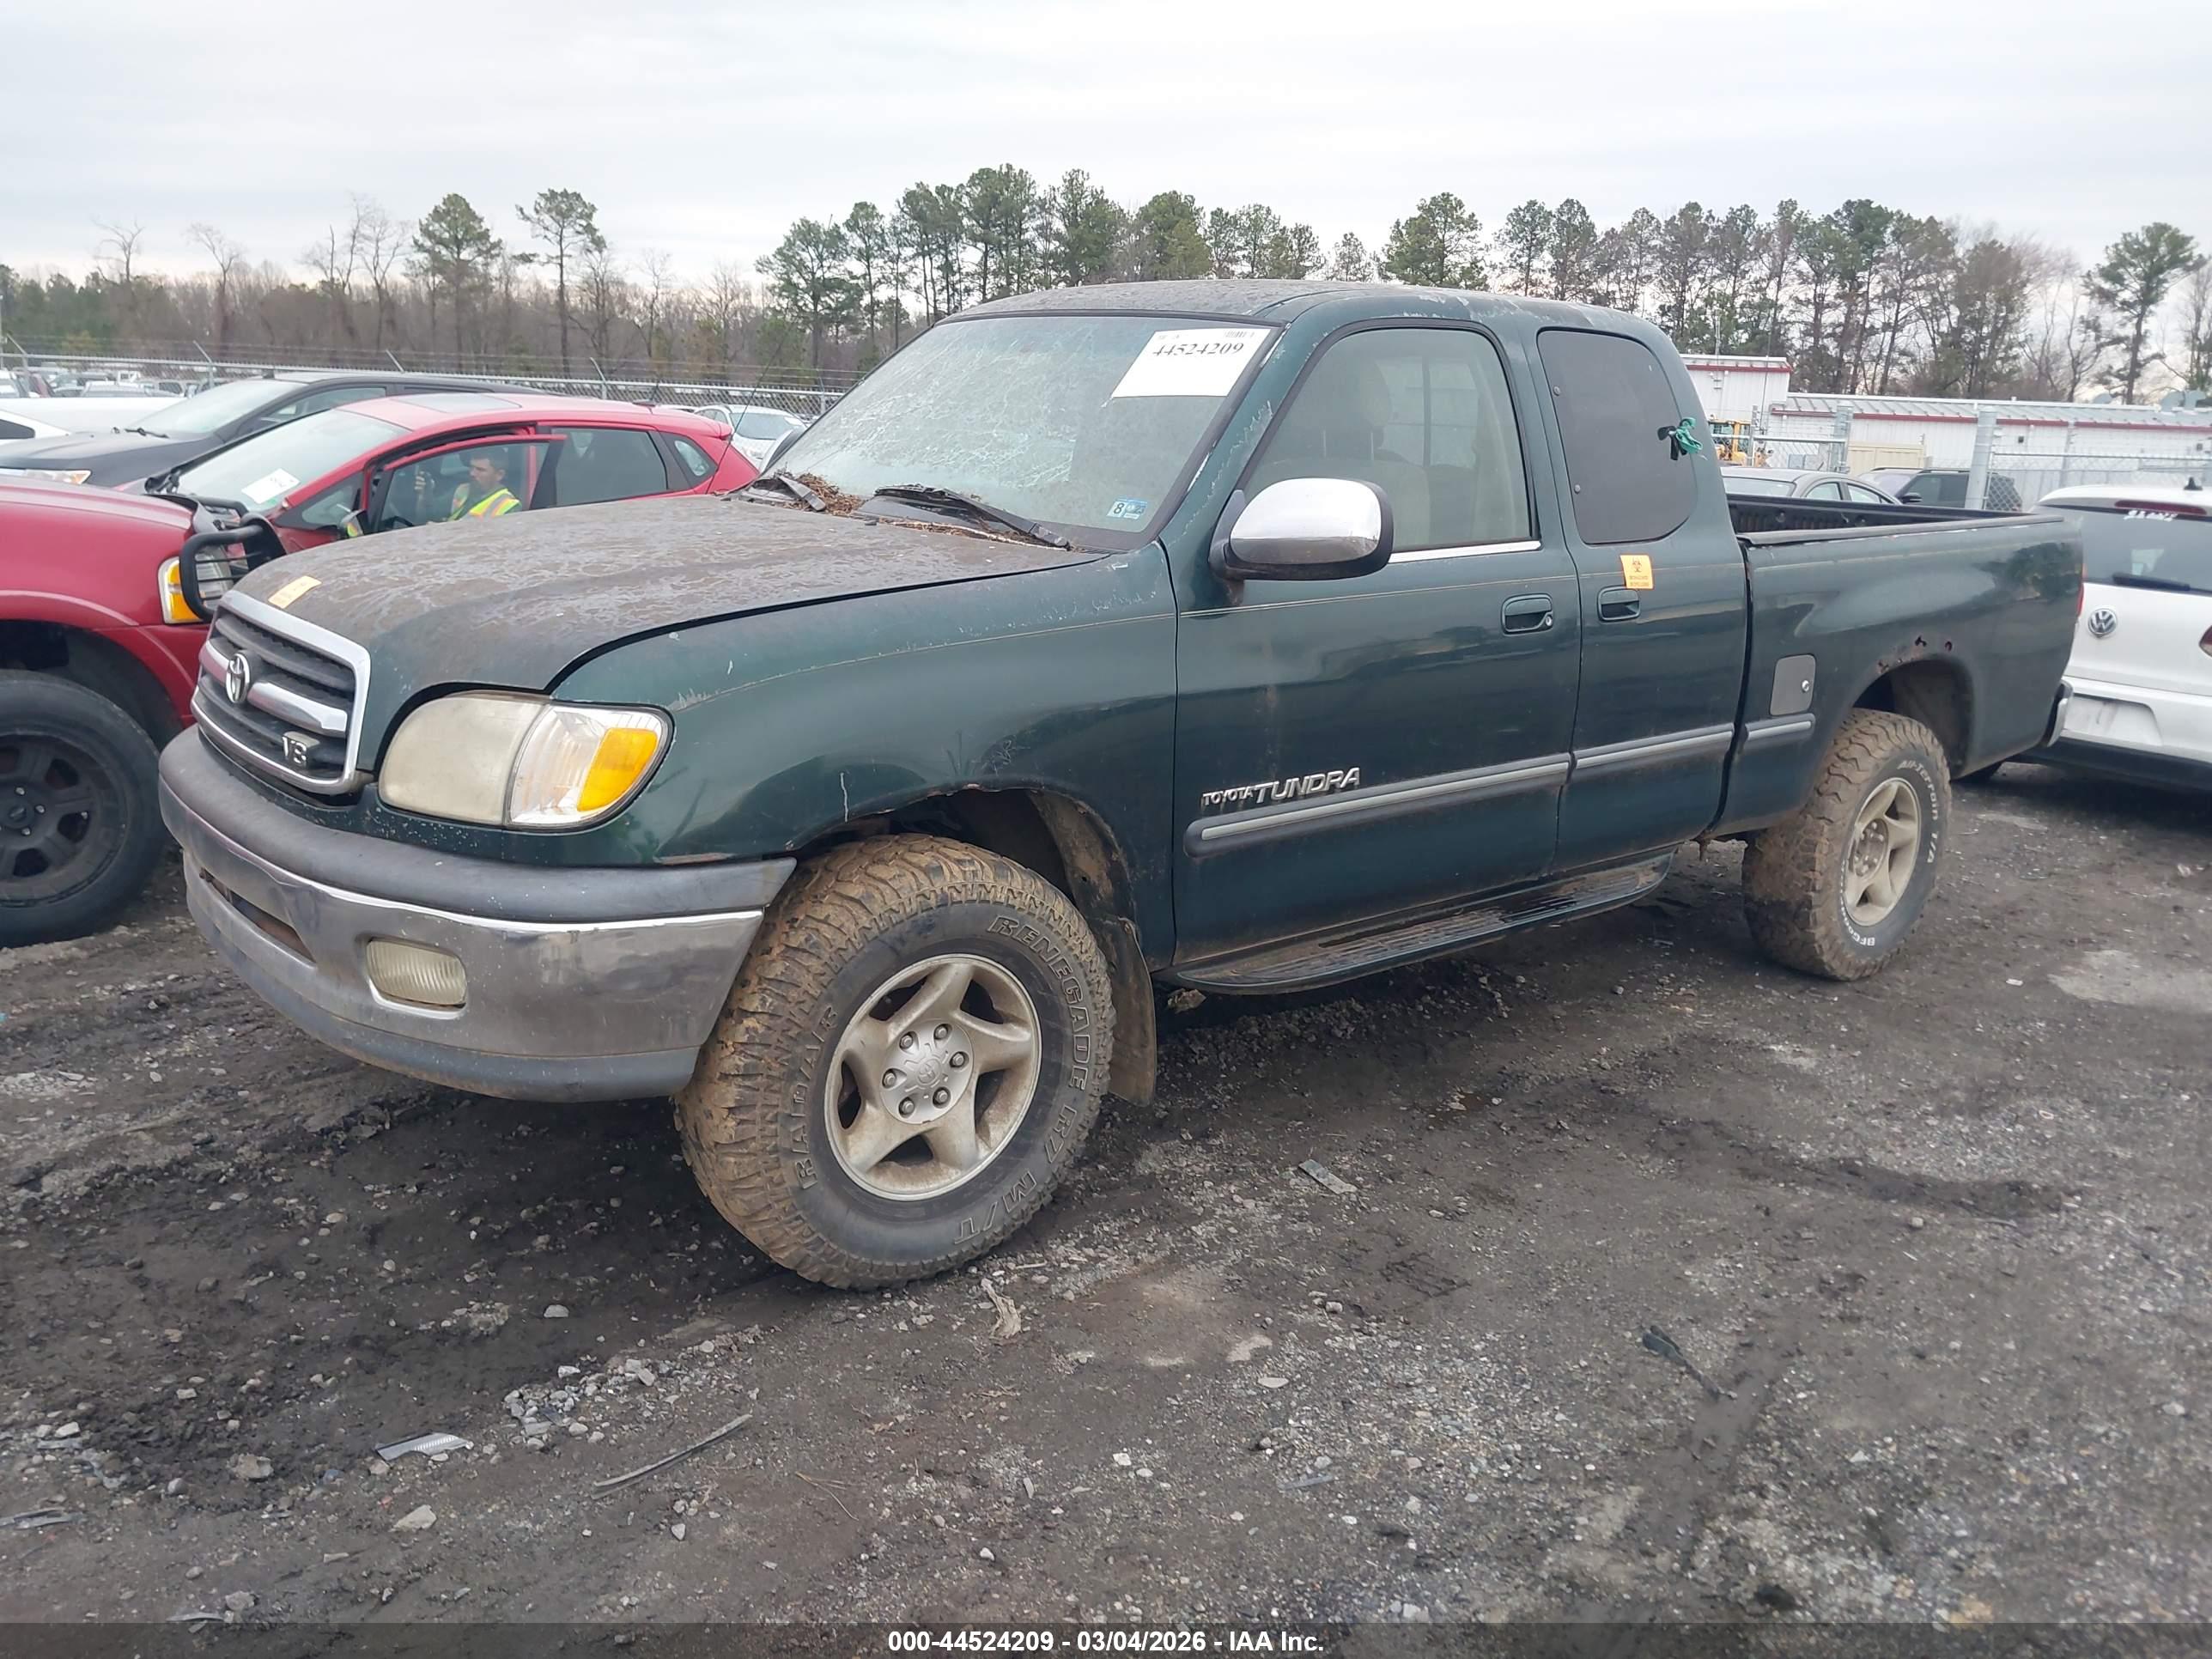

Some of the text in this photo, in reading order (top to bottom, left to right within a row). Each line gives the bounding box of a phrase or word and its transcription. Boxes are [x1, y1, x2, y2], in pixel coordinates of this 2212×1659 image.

[1152, 343, 1244, 356] 44524209
[1113, 502, 1125, 514] 8
[282, 736, 307, 765] V8
[1203, 767, 1361, 806] TOYOTA TUNDRA
[987, 915, 1091, 1092] RENEGADE
[1045, 1104, 1078, 1164] R7
[954, 1170, 1037, 1244] M/T
